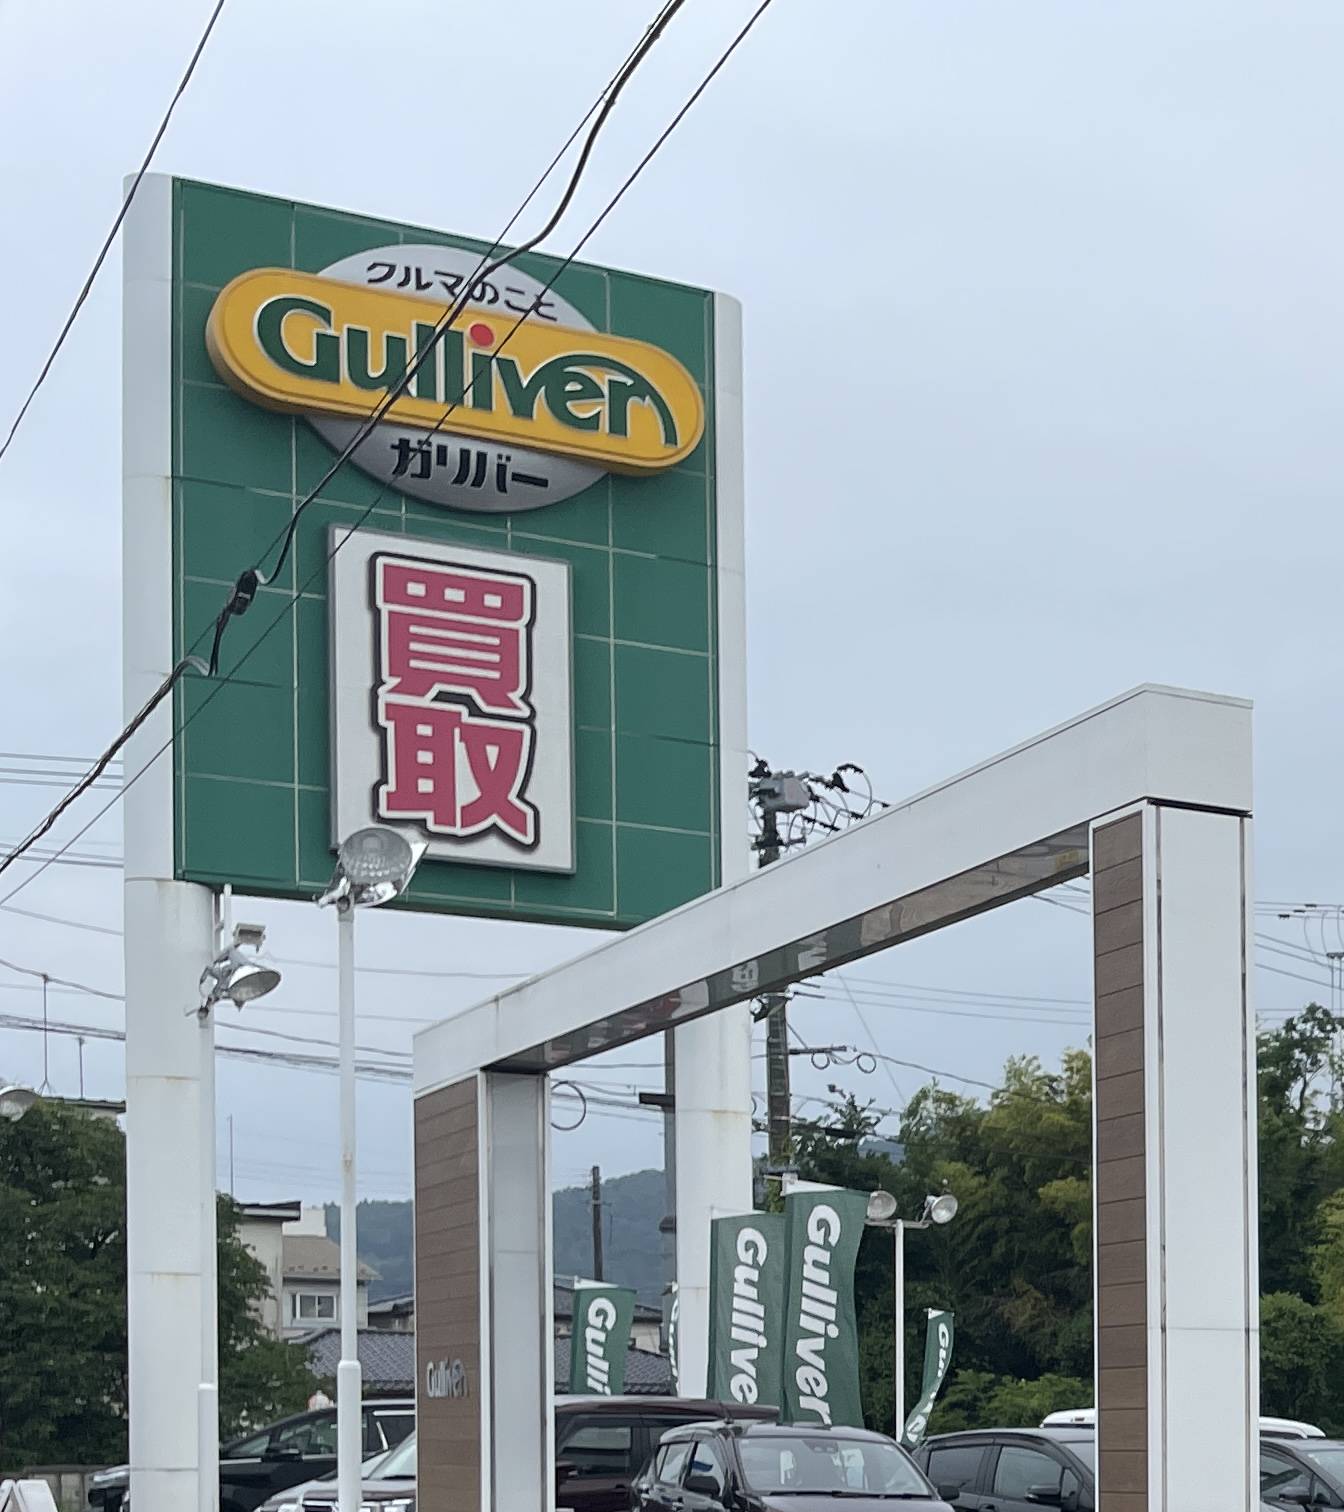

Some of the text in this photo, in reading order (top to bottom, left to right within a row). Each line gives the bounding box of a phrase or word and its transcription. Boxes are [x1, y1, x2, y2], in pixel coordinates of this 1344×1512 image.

[366, 261, 558, 322] クルマのこと
[253, 296, 678, 448] Gulliver
[390, 438, 549, 494] ガリバー
[373, 553, 538, 845] 買取
[585, 1297, 617, 1397] Gulli
[729, 1227, 768, 1405] Gullive
[796, 1204, 842, 1426] Gulliver
